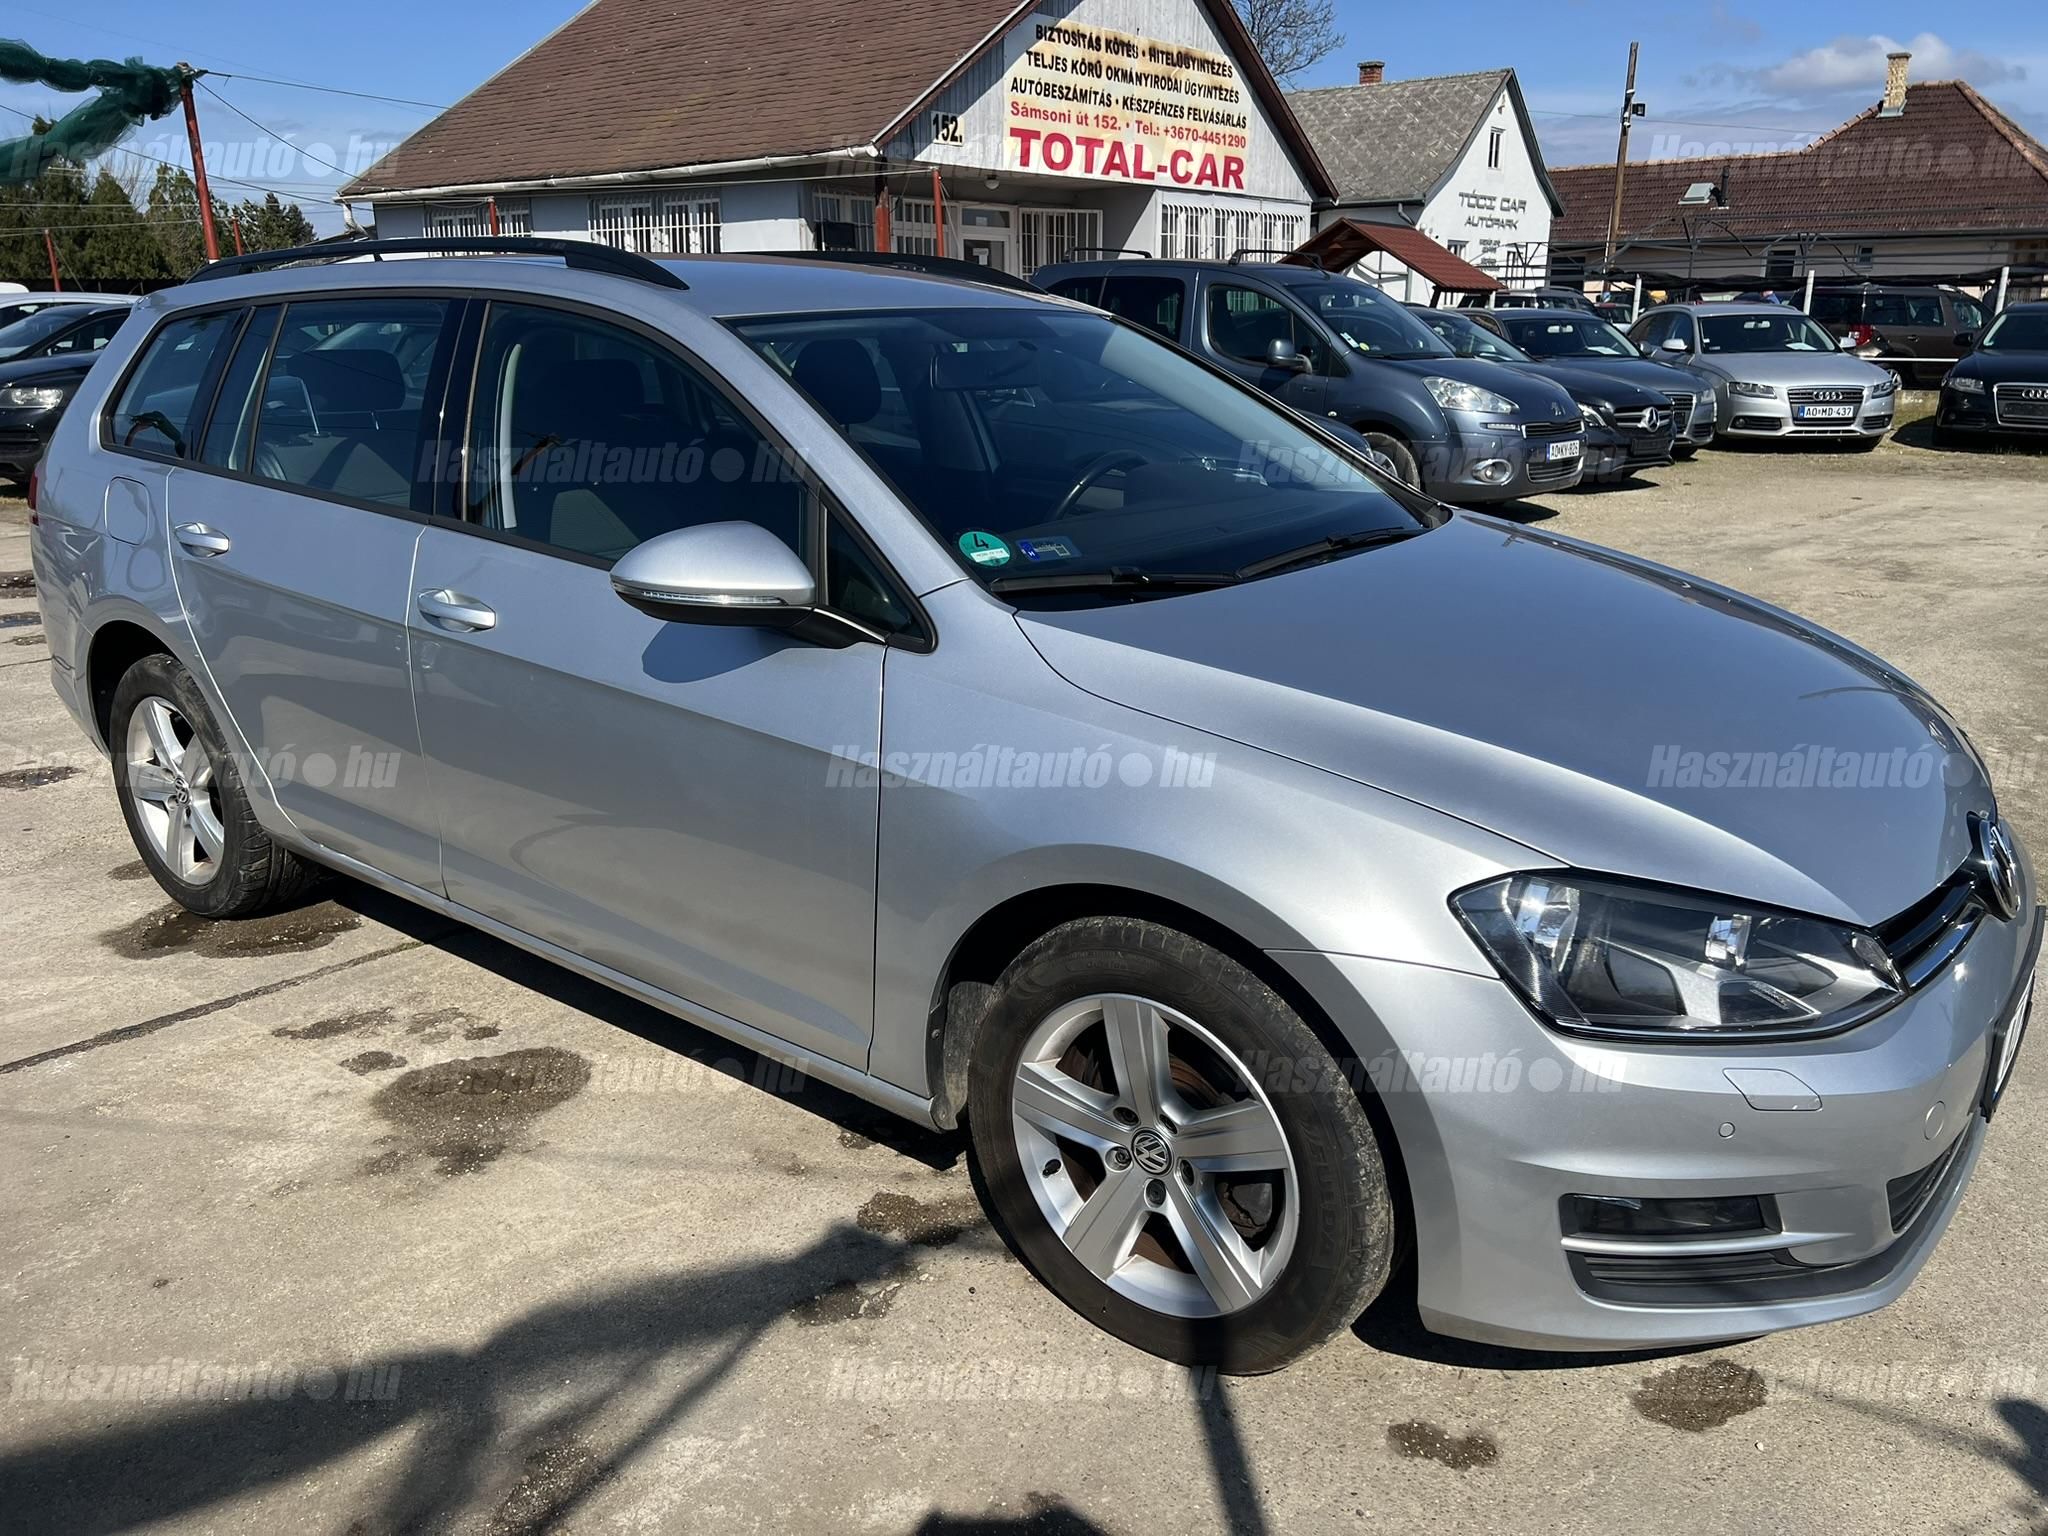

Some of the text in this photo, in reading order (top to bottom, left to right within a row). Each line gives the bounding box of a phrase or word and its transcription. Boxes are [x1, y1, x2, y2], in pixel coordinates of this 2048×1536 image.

[1036, 24, 1101, 52] BIZTOSÍTÁS
[1026, 50, 1068, 73] TELJES
[1105, 65, 1182, 93] OKMÁNYIRODAI
[1184, 79, 1240, 104] ÜGYINTÉZÉS
[1010, 77, 1247, 129] AUTÓBESZÁMÍTÁS KÉSZPÉNZES FELVÁSÁRLÁS
[932, 113, 963, 143] 152.
[1010, 101, 1071, 124] Sámsoni
[1076, 112, 1089, 127] út
[1135, 120, 1160, 137] Tel.:
[1163, 125, 1247, 149] +3670-4451290
[1009, 127, 1245, 190] TOTAL-CAR
[1500, 197, 1527, 214] CAR
[1464, 214, 1519, 230] AUTÓPARK
[973, 533, 989, 549] 4
